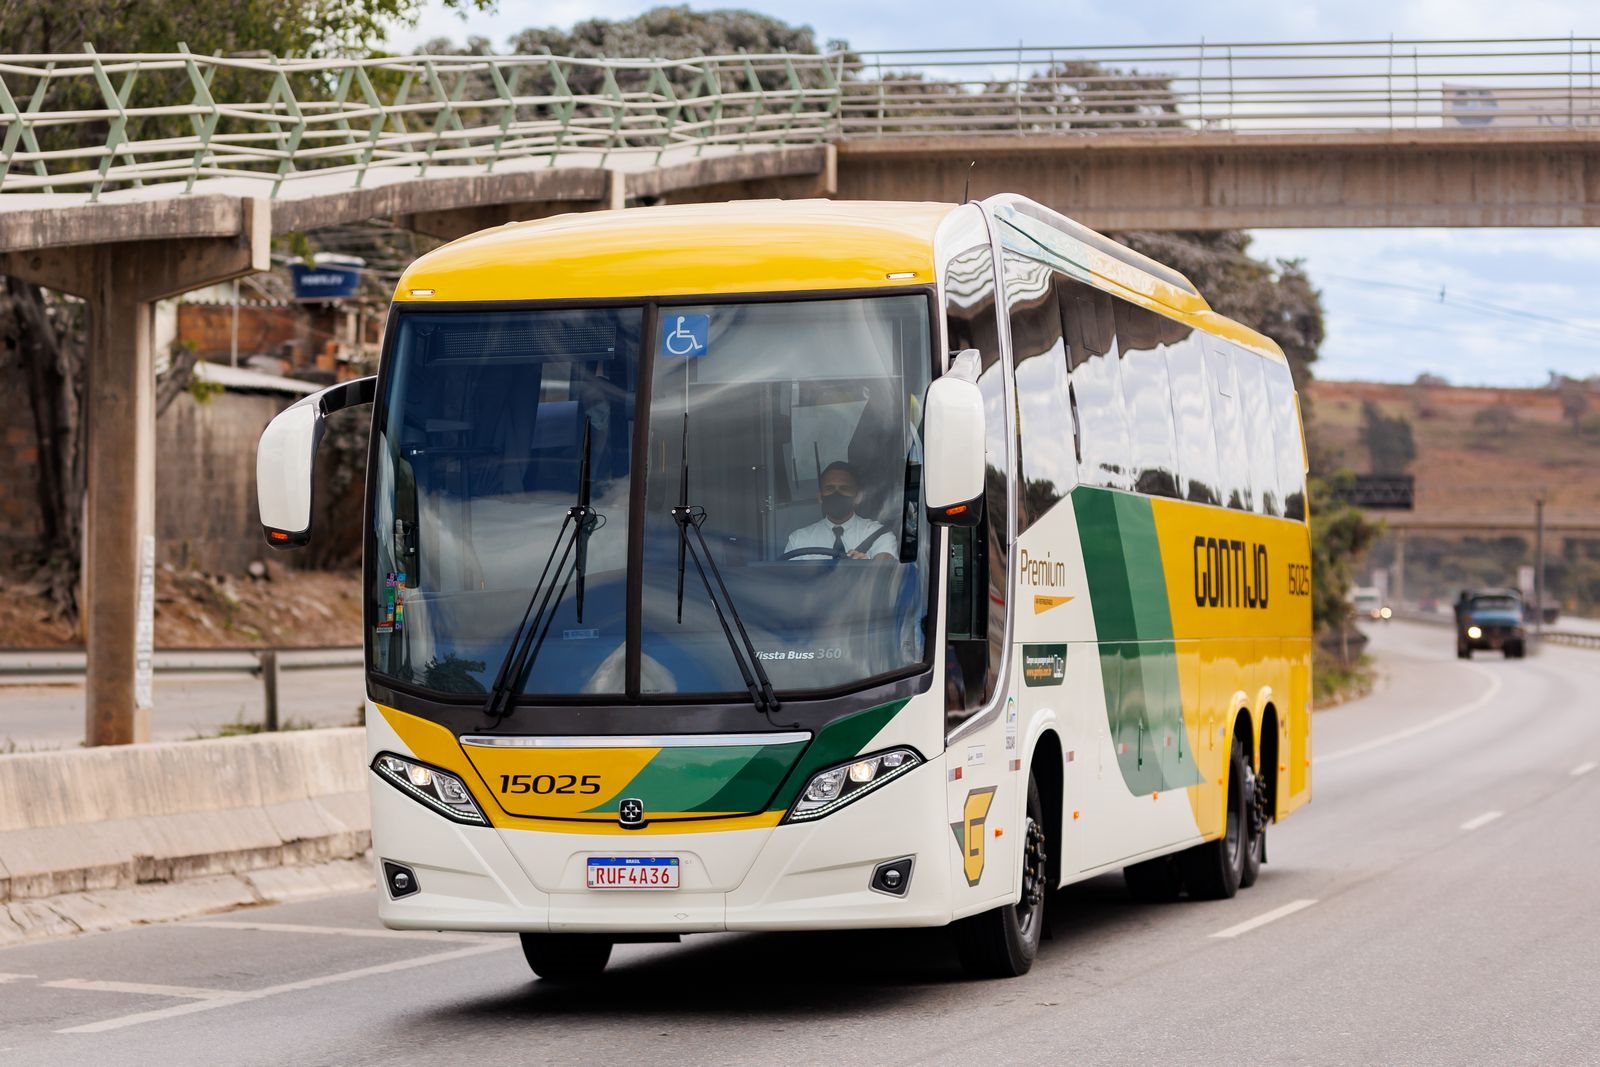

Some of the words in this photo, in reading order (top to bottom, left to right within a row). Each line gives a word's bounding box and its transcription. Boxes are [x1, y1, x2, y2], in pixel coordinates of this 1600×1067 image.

[1020, 548, 1066, 587] Premium
[1194, 535, 1268, 609] GONTIJO
[1288, 563, 1310, 596] 15025
[787, 650, 815, 660] Buss
[817, 648, 842, 660] 360
[500, 774, 602, 795] 15025
[596, 868, 670, 884] RUF4A36
